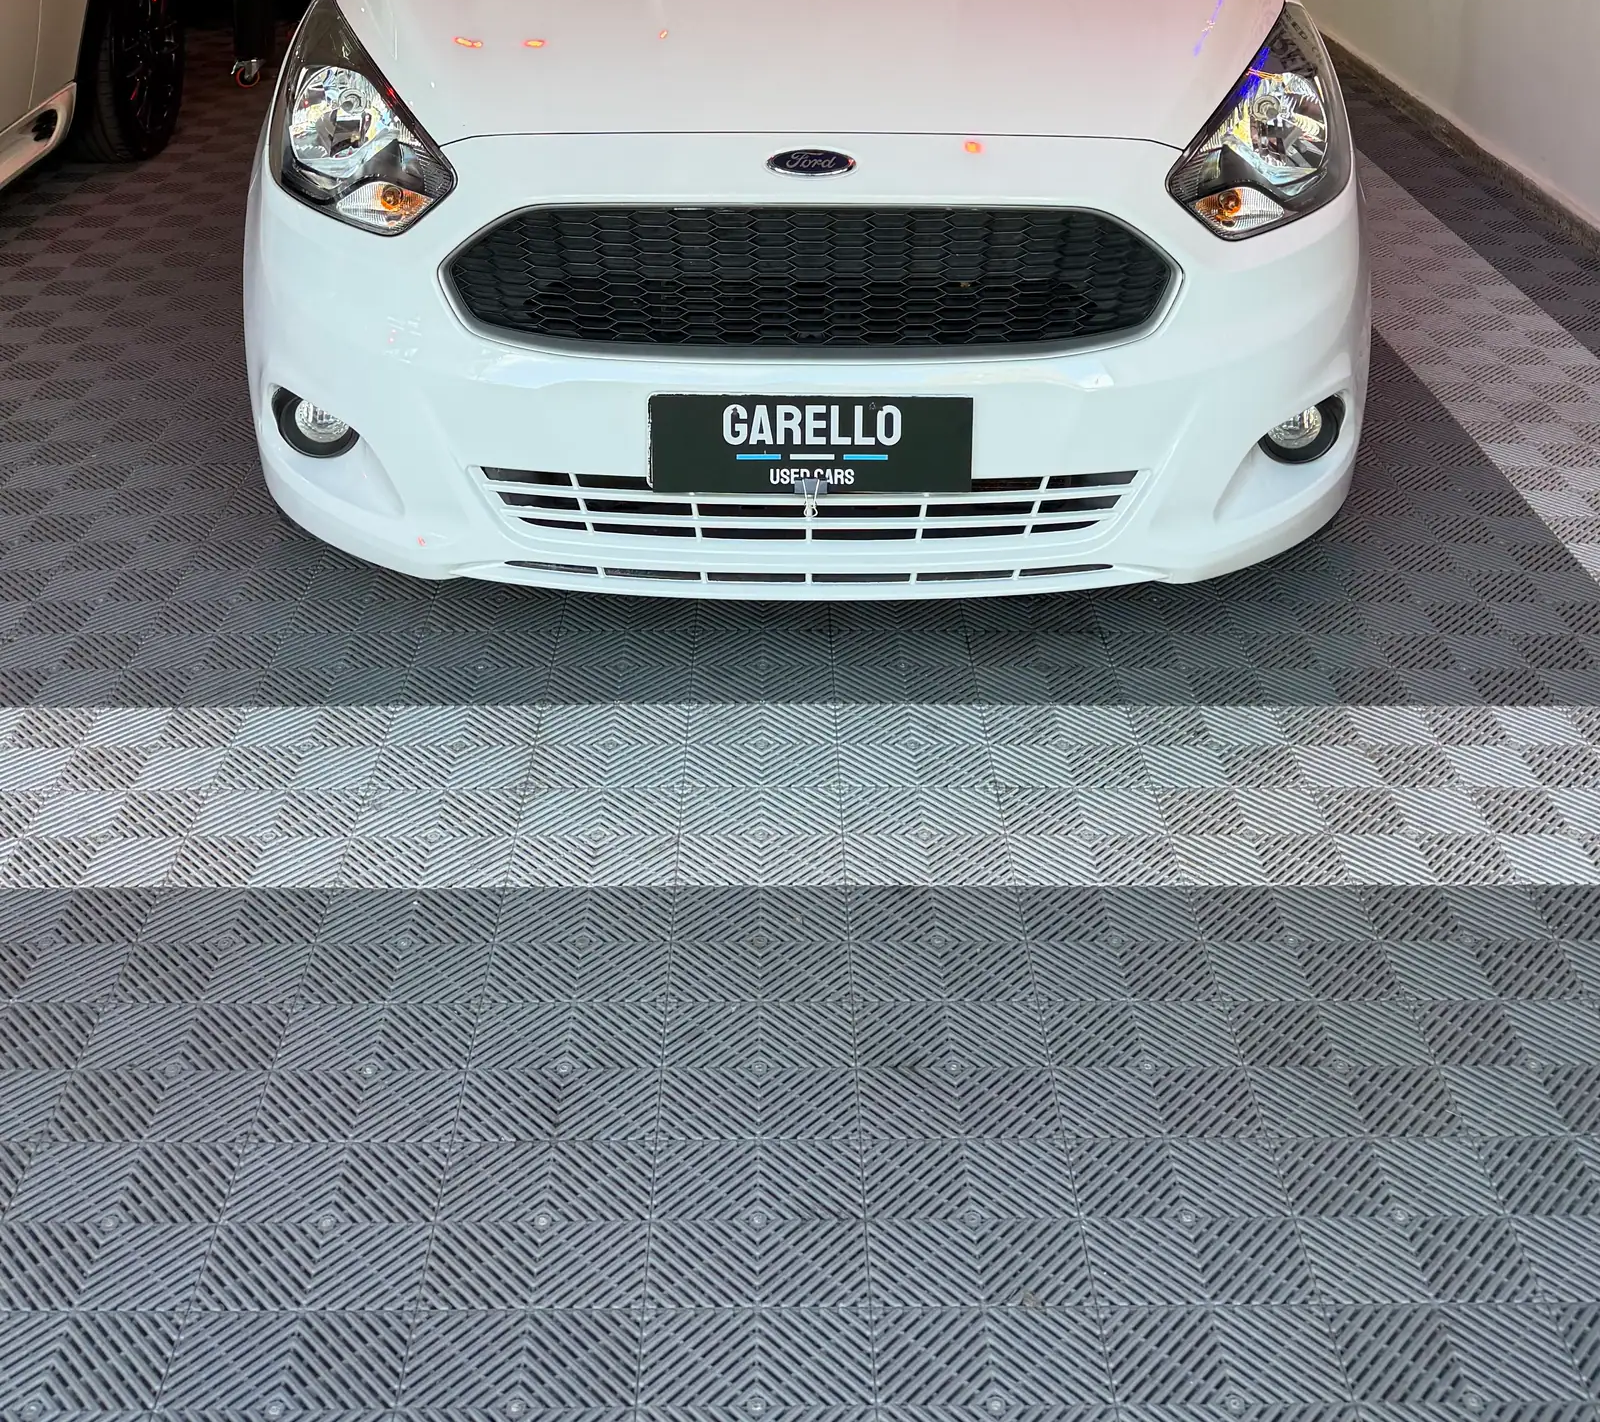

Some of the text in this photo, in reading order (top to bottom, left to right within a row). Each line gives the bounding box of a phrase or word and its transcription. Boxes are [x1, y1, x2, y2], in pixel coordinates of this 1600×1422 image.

[786, 152, 837, 169] Ford
[722, 404, 902, 446] GARELLO
[769, 468, 855, 485] USED CARS
